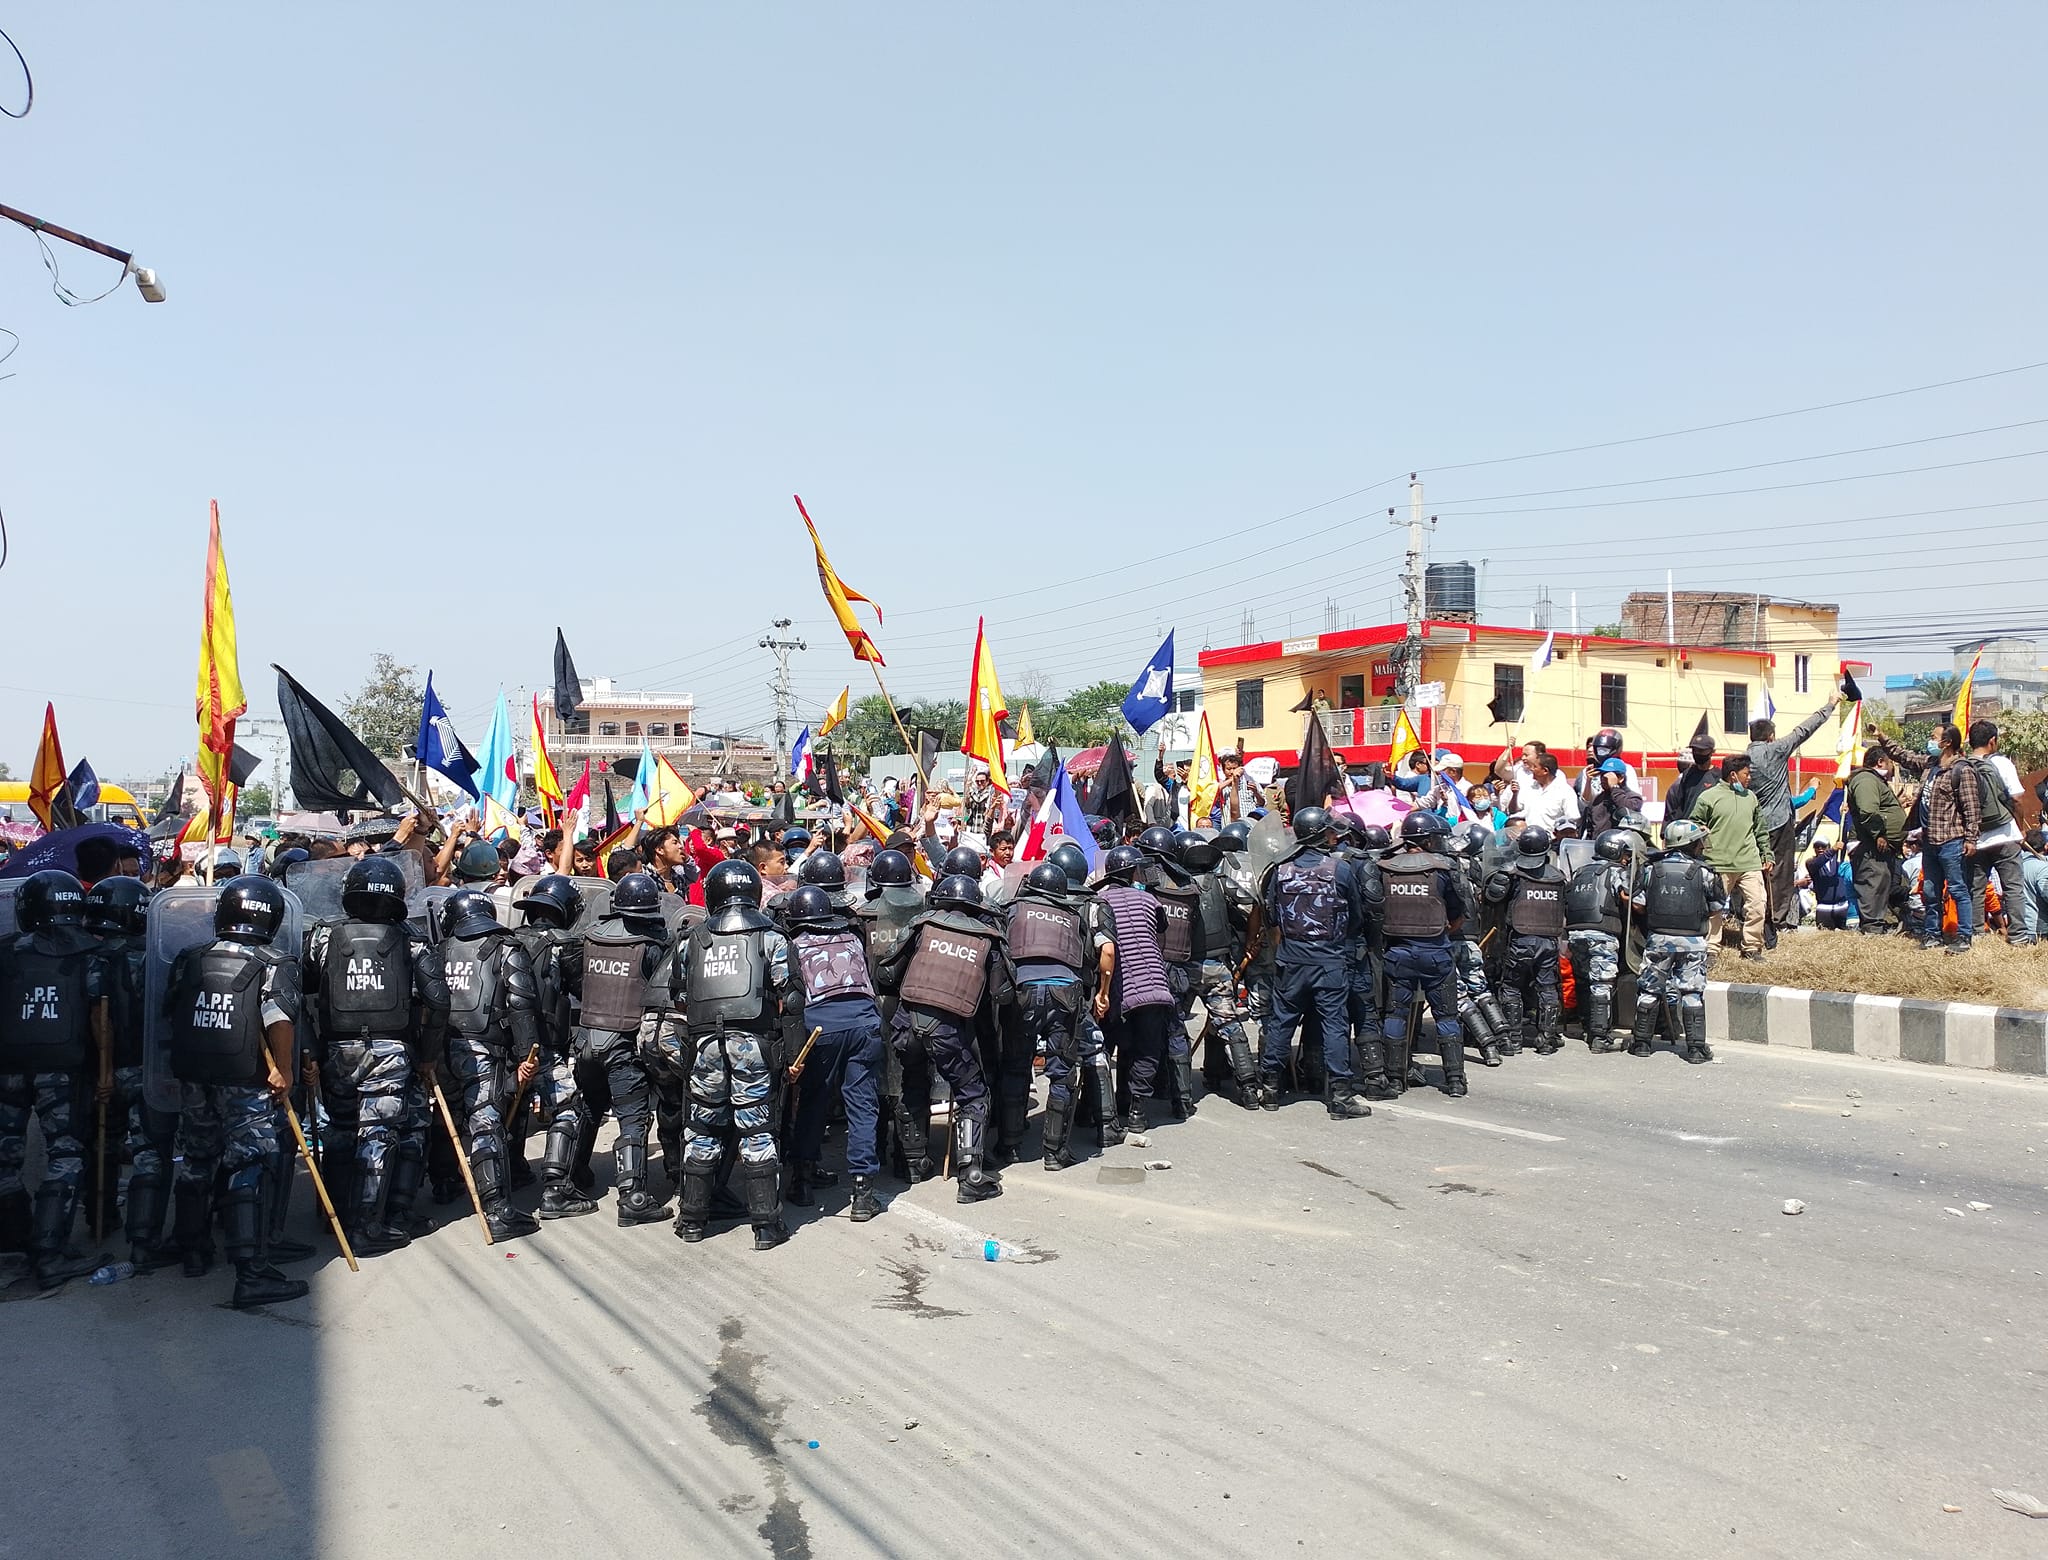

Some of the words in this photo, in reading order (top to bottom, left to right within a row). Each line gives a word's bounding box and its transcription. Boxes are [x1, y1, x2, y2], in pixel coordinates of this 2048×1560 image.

[367, 882, 395, 893] NEPAL
[725, 874, 753, 885] NEPAL
[55, 891, 82, 901] NEPAL
[1390, 884, 1429, 896] POLICE
[1526, 890, 1558, 901] POLICE
[241, 899, 272, 913] NEPAL
[1026, 910, 1072, 929] POLICE
[704, 944, 739, 962] A.P.F.
[928, 939, 978, 963] POLICE
[588, 958, 631, 977] POLICE
[703, 960, 739, 978] NEPAL
[346, 974, 385, 991] NEPAL
[195, 991, 235, 1011] A.P.F.
[193, 1010, 232, 1030] NEPAL
